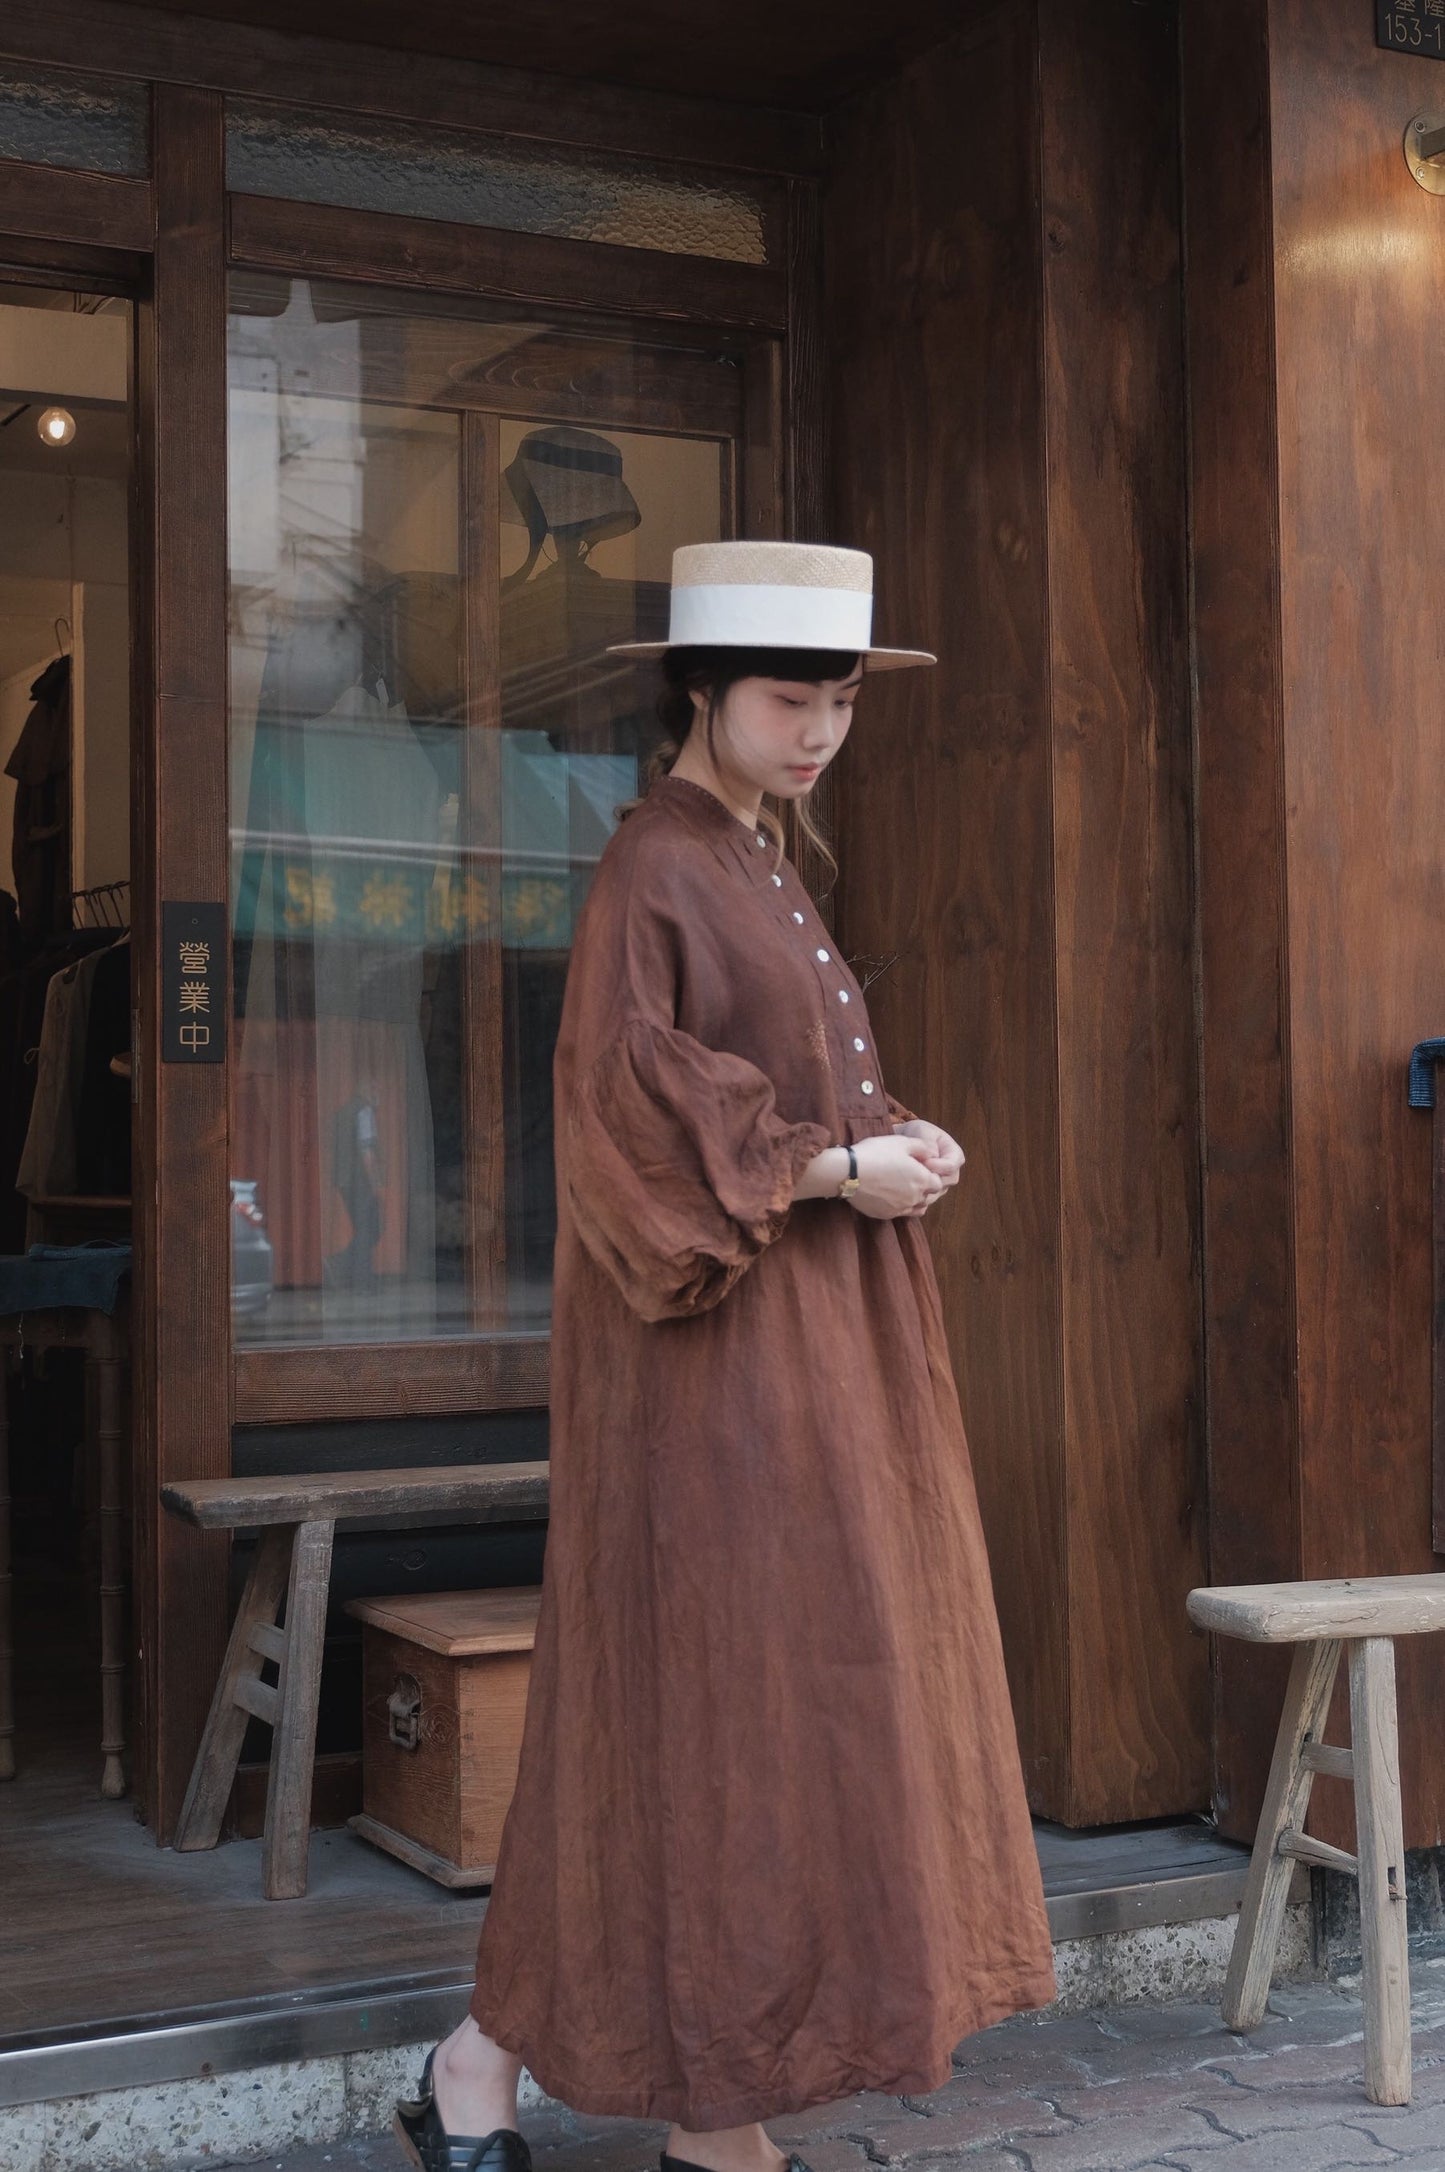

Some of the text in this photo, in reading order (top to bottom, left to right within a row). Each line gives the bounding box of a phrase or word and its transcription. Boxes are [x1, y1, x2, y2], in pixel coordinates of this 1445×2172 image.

[1385, 13, 1441, 51] 153-1
[178, 941, 210, 1053] 營業中
